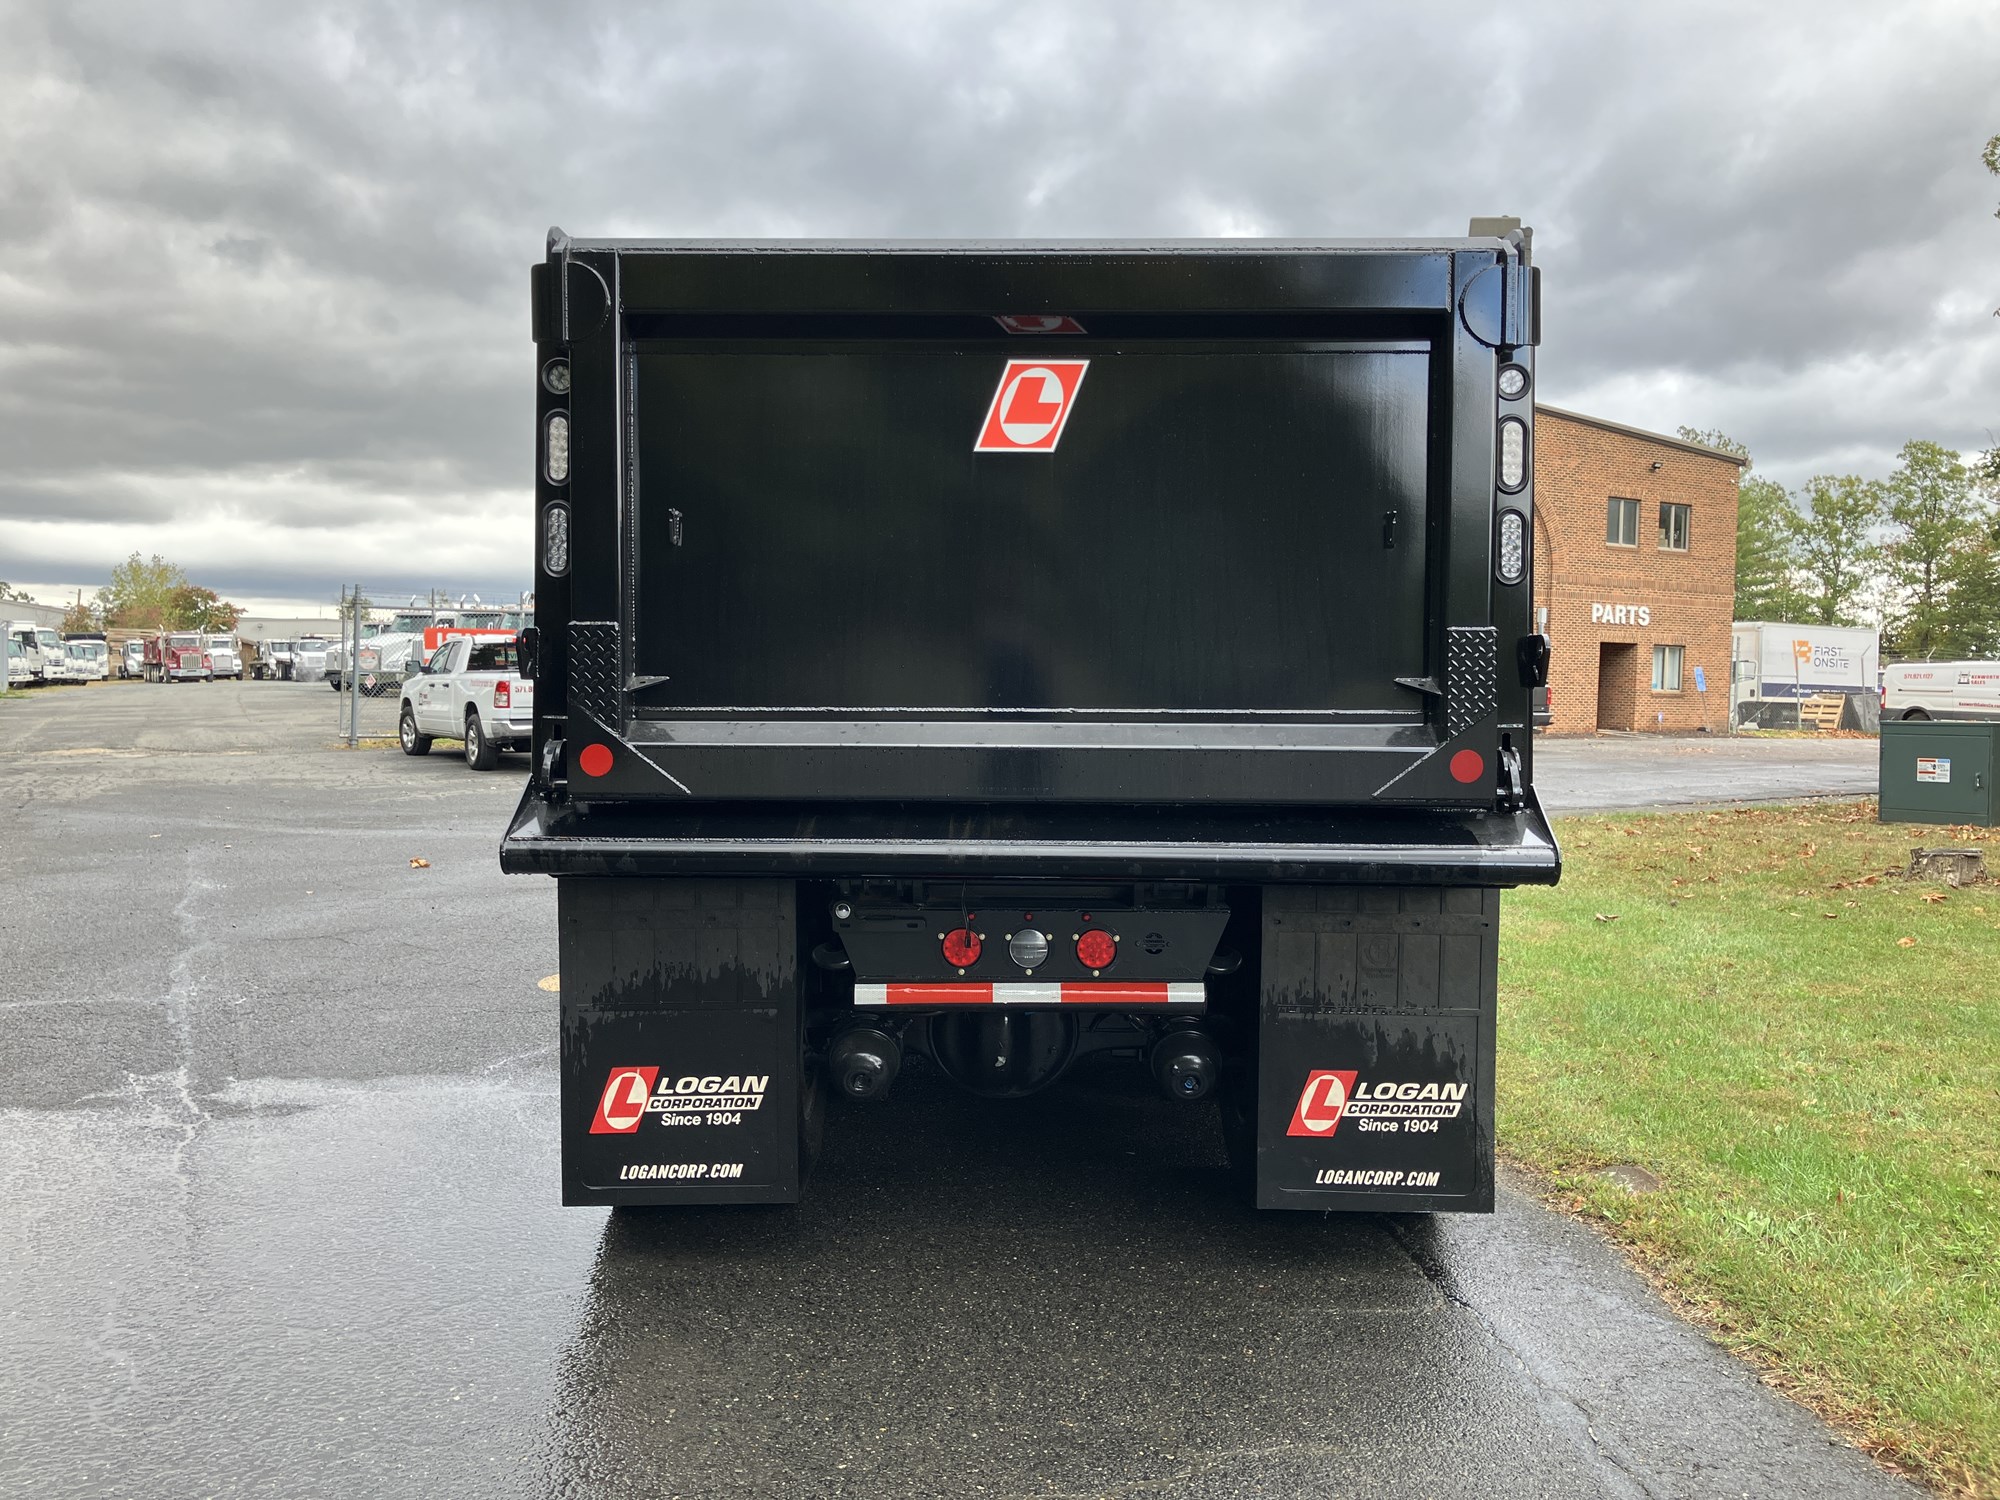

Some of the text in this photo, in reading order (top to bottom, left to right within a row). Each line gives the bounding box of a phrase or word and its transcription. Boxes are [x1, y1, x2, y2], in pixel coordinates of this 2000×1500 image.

[1591, 603, 1651, 627] PARTS
[1814, 646, 1844, 657] FIRST
[1813, 657, 1850, 669] ONSITE
[656, 1075, 770, 1095] LOGAN
[1355, 1082, 1469, 1102] LOGAN
[650, 1097, 758, 1110] CORPORATION
[1347, 1103, 1457, 1116] CORPORATION
[660, 1112, 742, 1127] Since 1904
[1358, 1117, 1439, 1134] Since 1904
[619, 1163, 744, 1181] LOGANCORP.COM
[1315, 1169, 1441, 1187] LOGANCORP.COM
